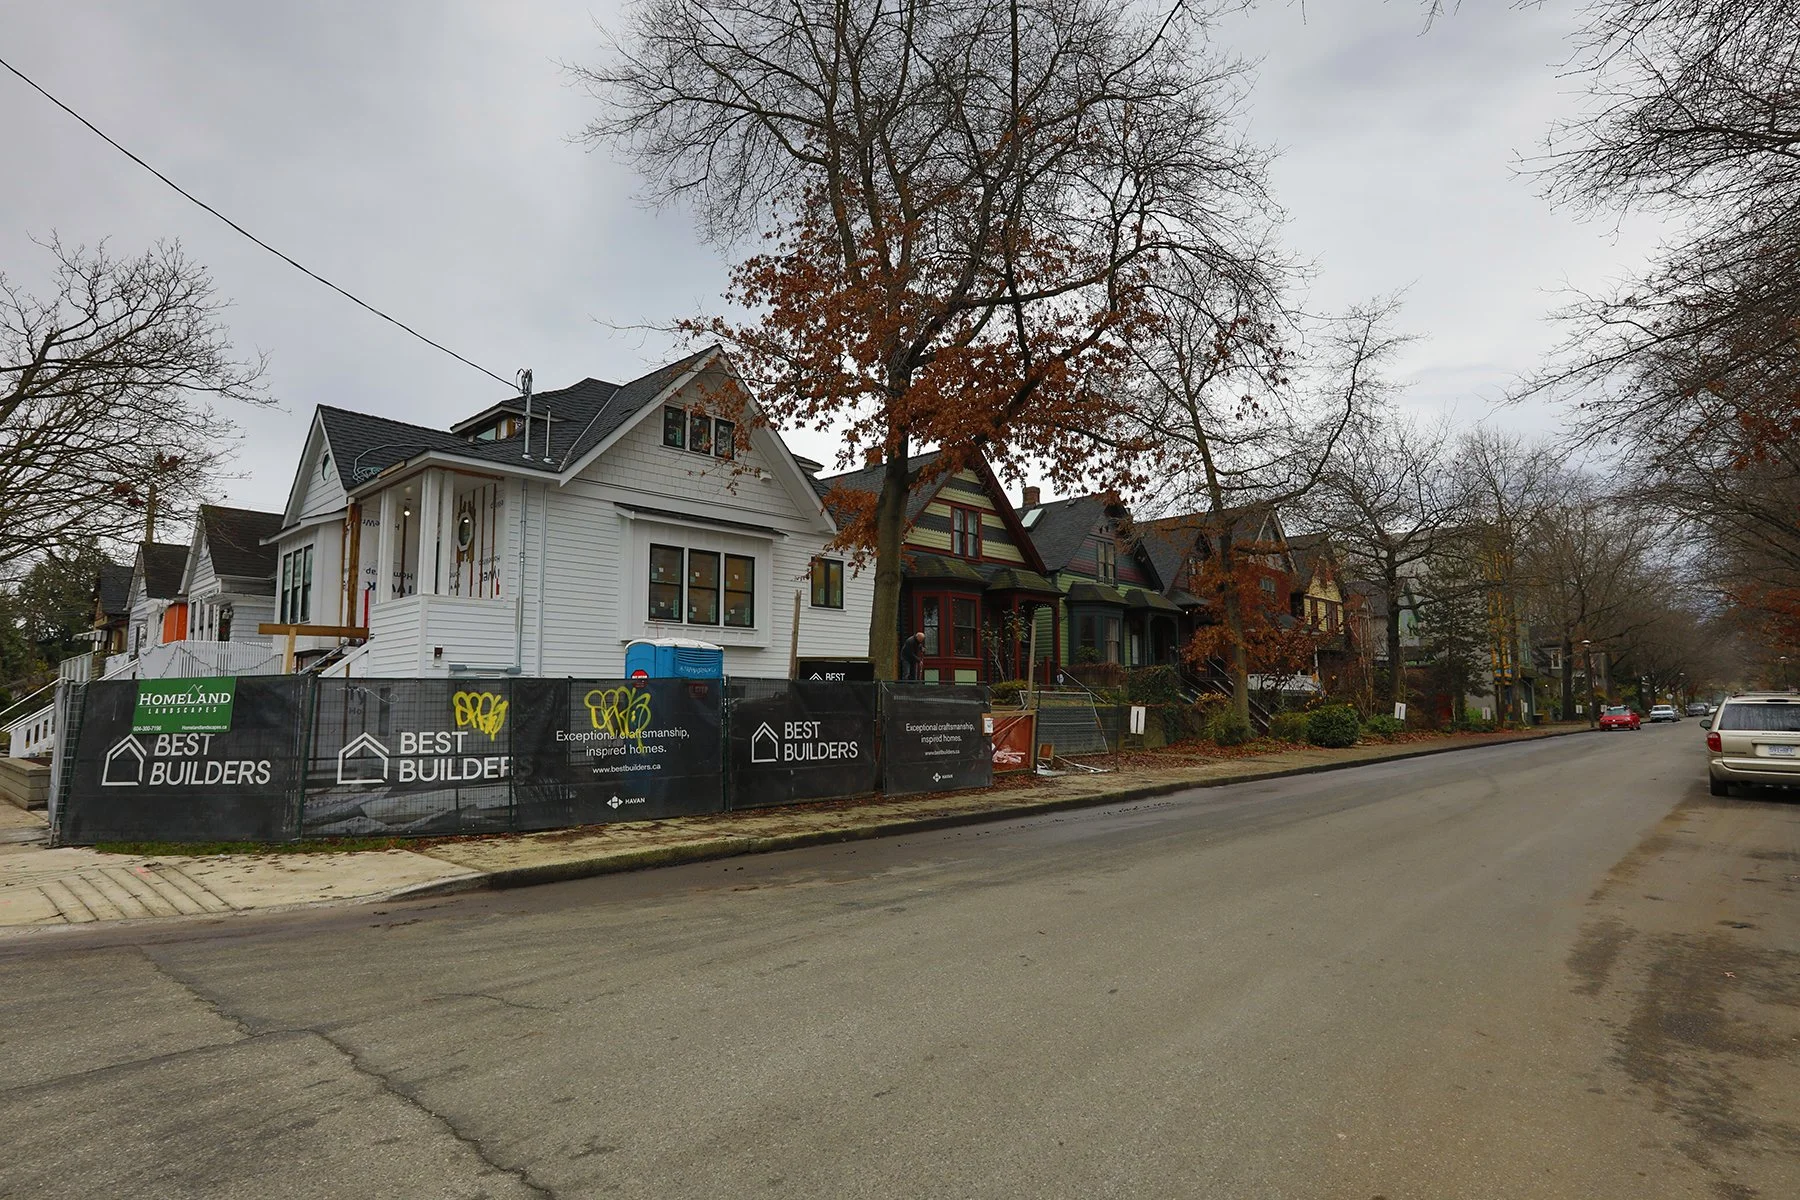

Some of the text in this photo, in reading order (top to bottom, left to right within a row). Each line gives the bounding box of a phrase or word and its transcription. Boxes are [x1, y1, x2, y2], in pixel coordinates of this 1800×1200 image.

[138, 692, 231, 706] HOMELAND
[148, 706, 217, 715] LANDSCAPES
[784, 721, 821, 739] BEST
[905, 721, 975, 733] Exceptional craftsmanship,
[400, 731, 469, 755] BEST
[556, 730, 618, 743] Exceptional
[920, 734, 942, 744] inspired
[154, 732, 215, 756] BEST
[784, 741, 859, 761] BUILDERS
[586, 744, 667, 759] inspired homes.
[149, 759, 271, 786] BUILDERS
[592, 763, 661, 774] www.bestbuilders.ca
